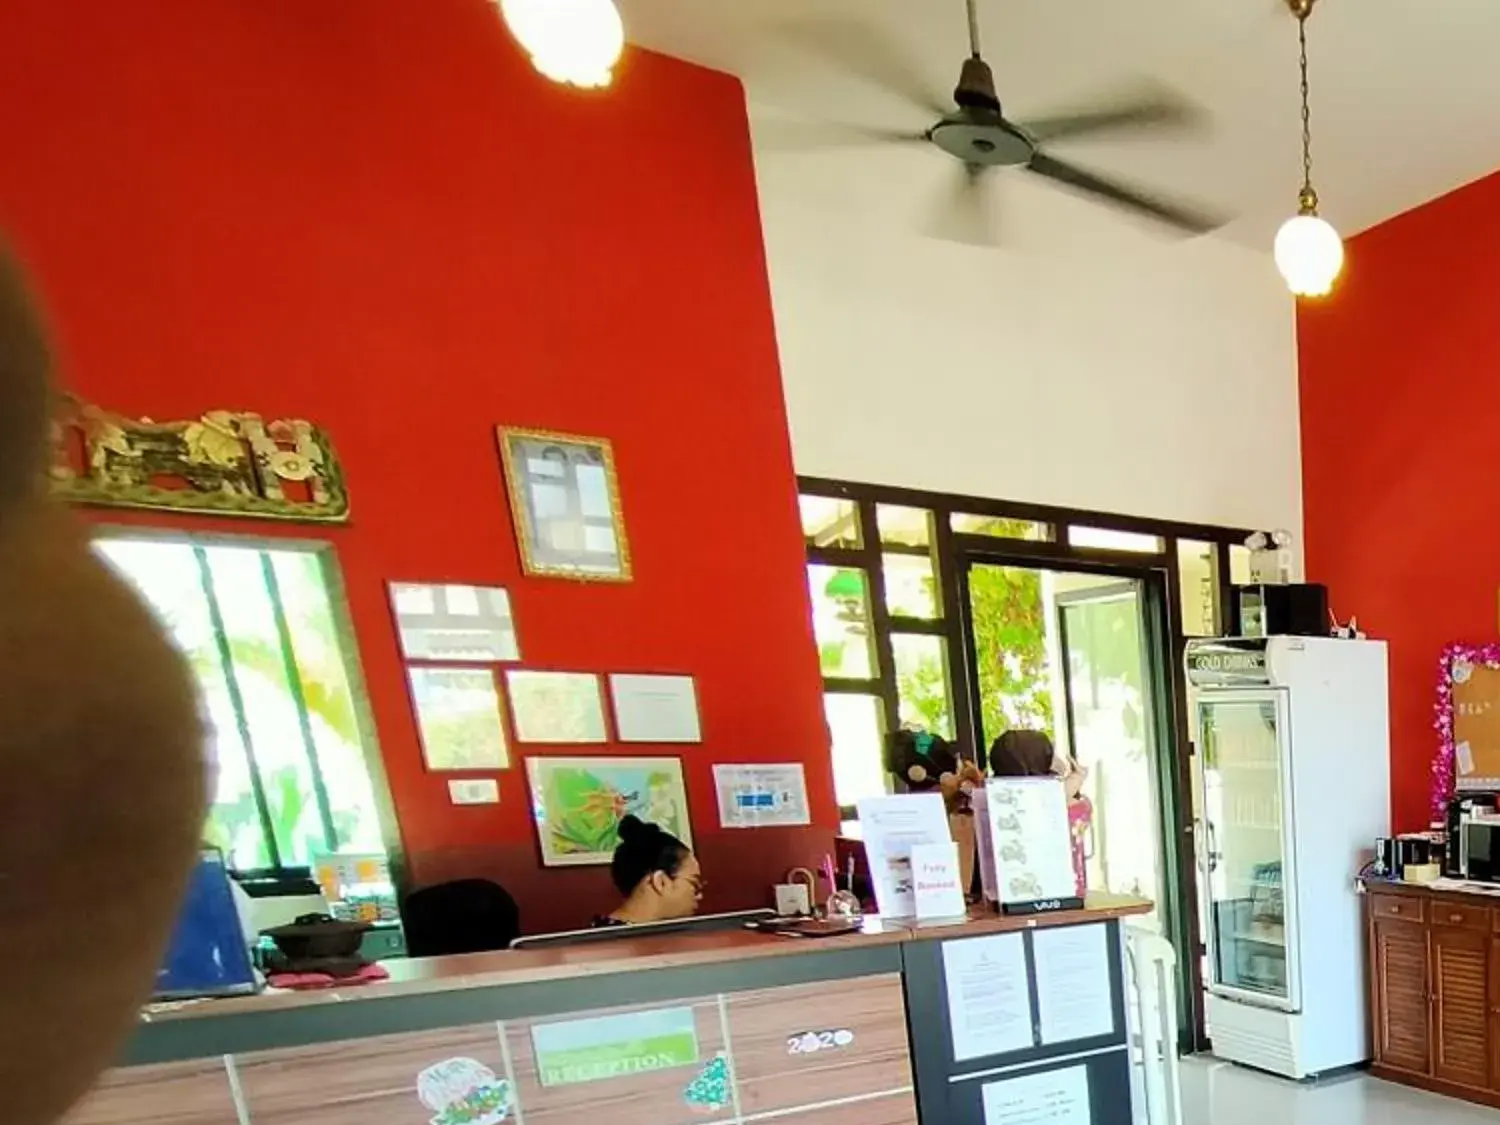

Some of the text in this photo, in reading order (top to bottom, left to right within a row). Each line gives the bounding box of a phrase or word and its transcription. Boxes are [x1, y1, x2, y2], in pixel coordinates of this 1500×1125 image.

[1196, 655, 1221, 671] COLD
[787, 1030, 854, 1056] 2020
[546, 1051, 674, 1084] RECEPTION
